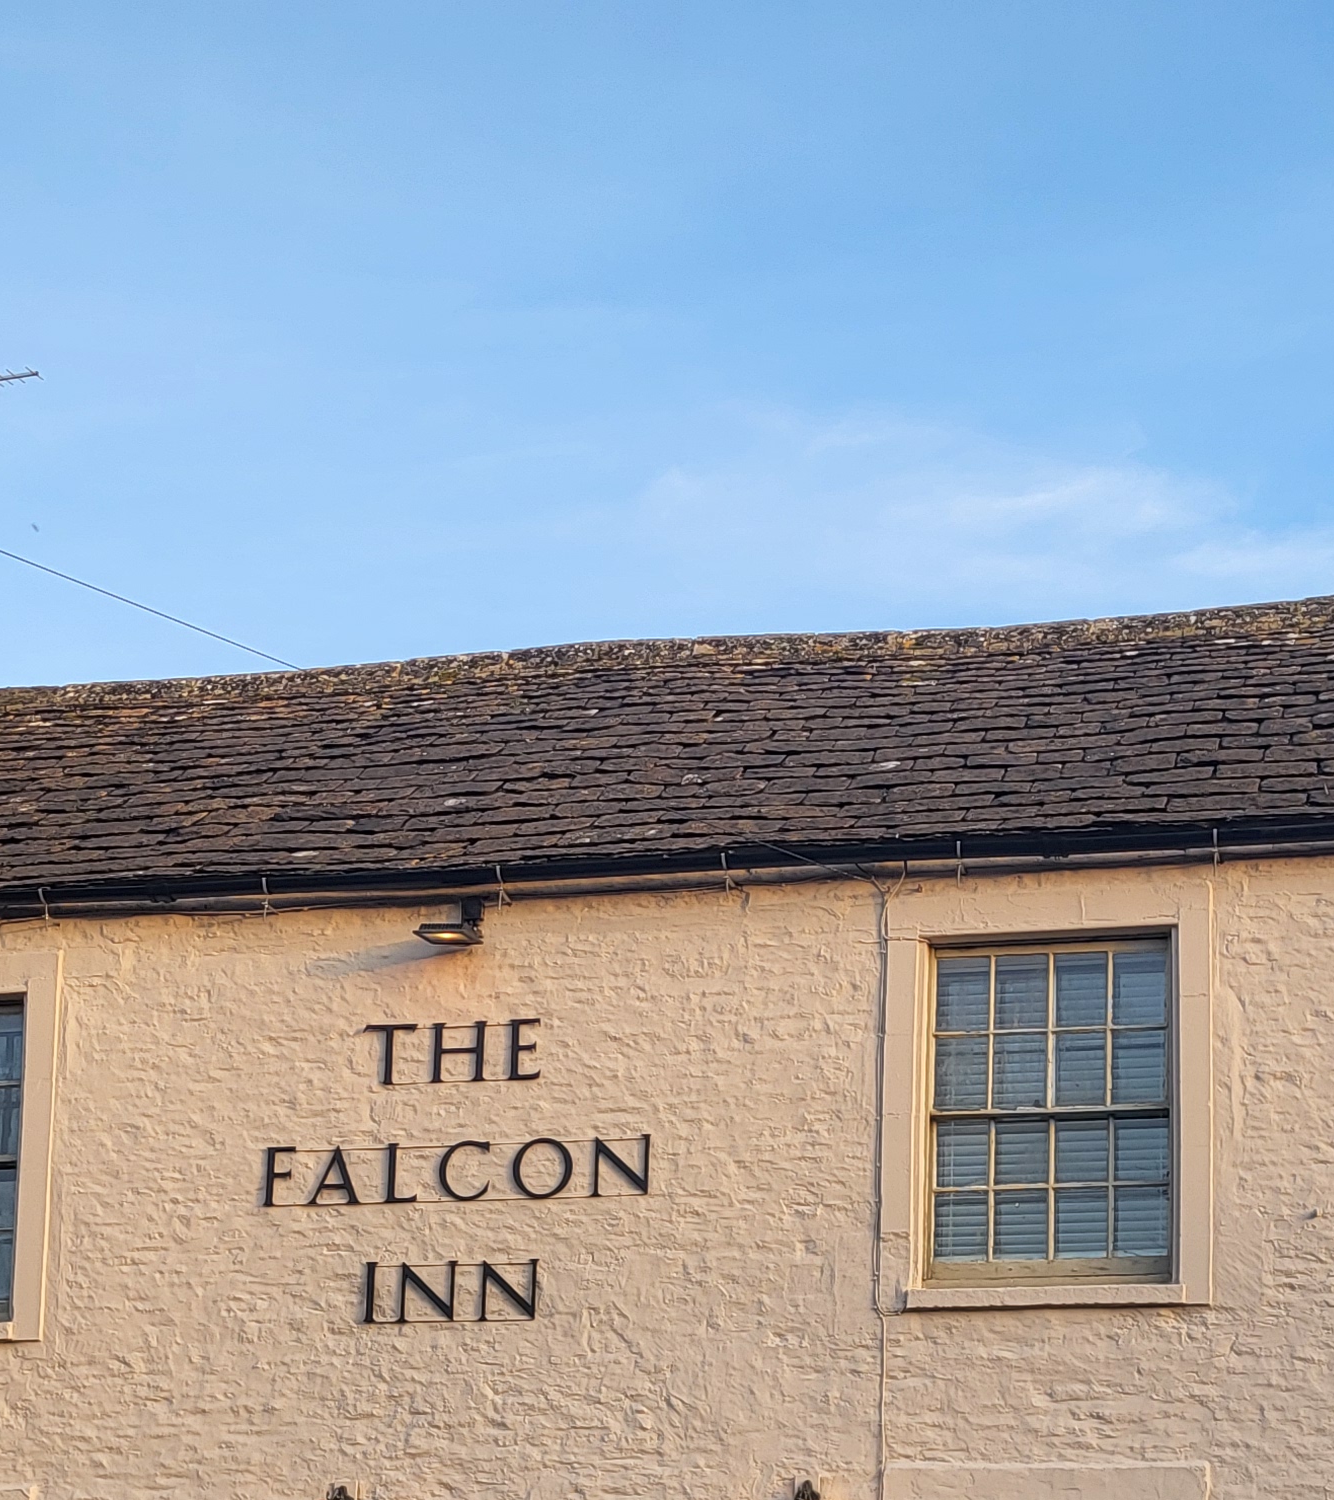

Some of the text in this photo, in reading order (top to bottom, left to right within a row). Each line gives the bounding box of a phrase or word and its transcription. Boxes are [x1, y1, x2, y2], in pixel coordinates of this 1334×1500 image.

[363, 1018, 541, 1085] THE
[262, 1134, 651, 1207] FALCON
[362, 1259, 540, 1323] INN
